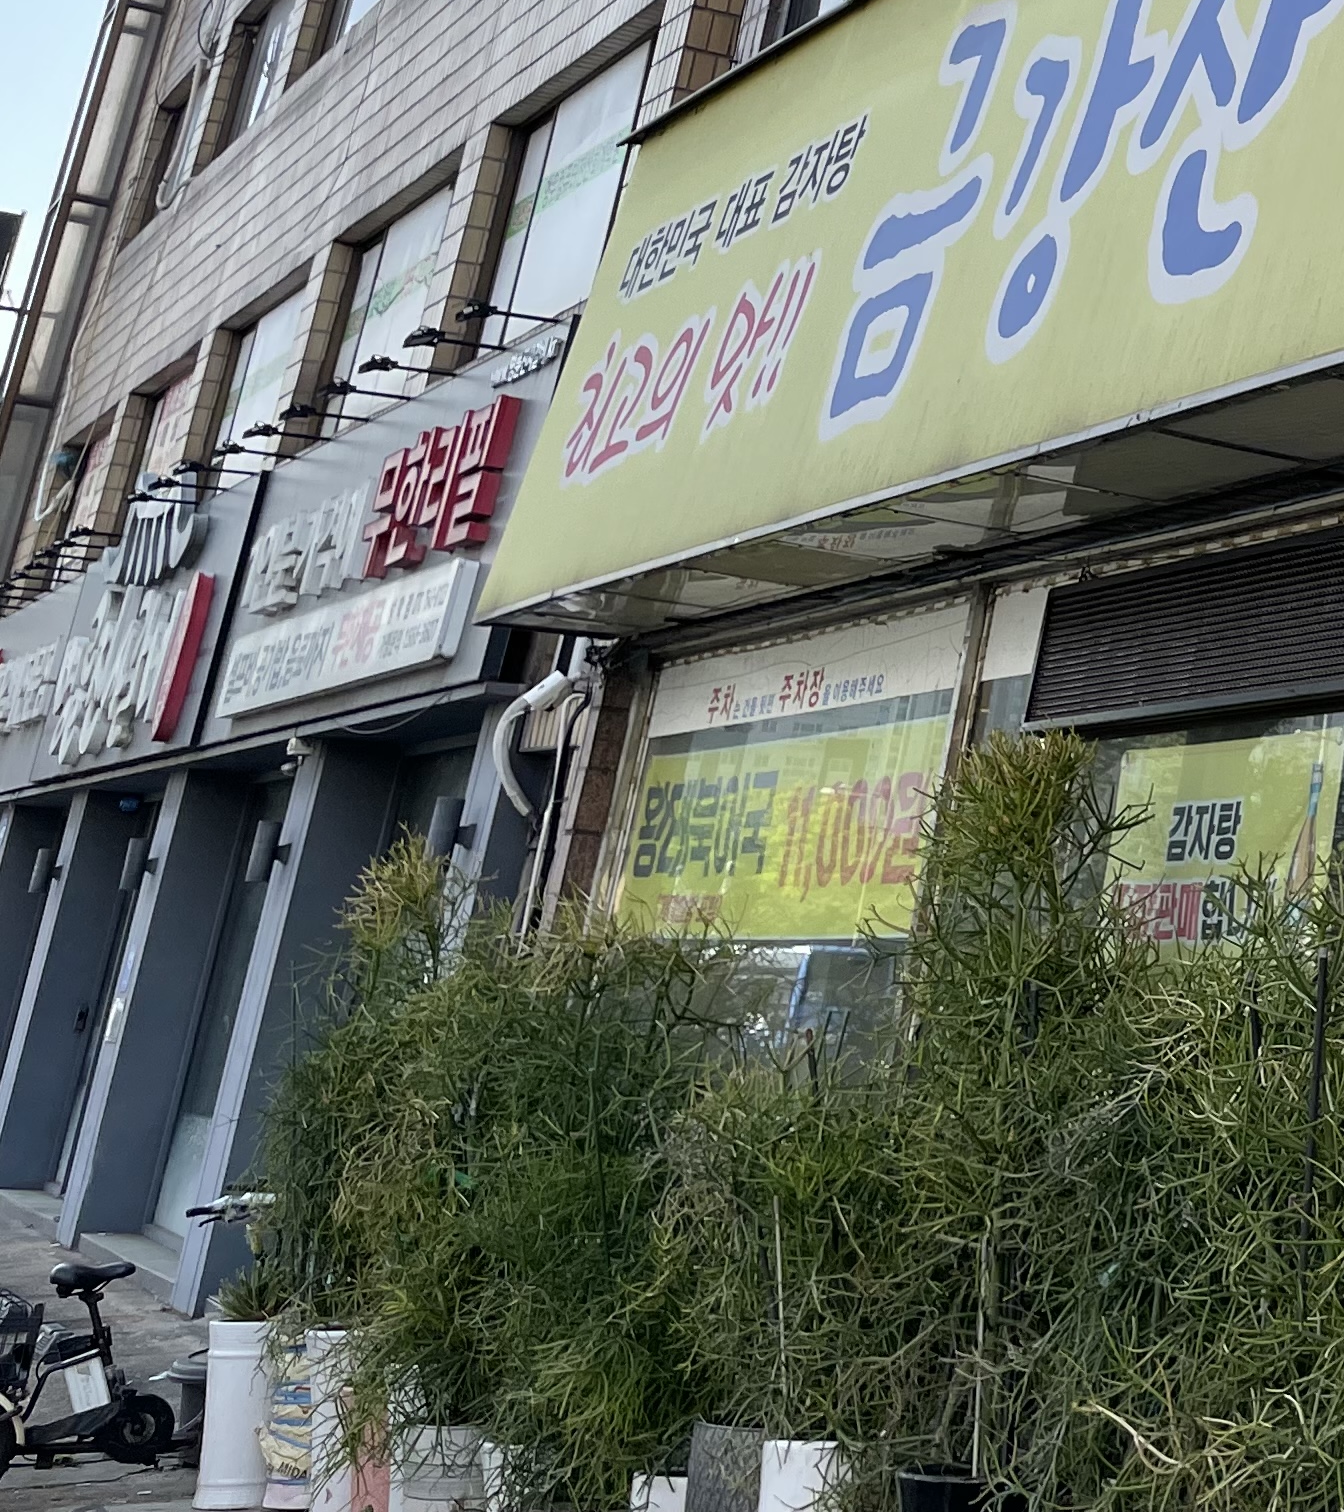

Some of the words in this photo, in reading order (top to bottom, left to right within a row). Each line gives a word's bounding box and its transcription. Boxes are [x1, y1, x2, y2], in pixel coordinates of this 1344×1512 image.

[619, 199, 718, 299] 대한민국
[715, 170, 775, 248] 대표
[772, 114, 868, 224] 감자탕
[566, 318, 711, 478] 최고의
[362, 394, 520, 579] 무한리필
[1166, 801, 1243, 862] 감자탕
